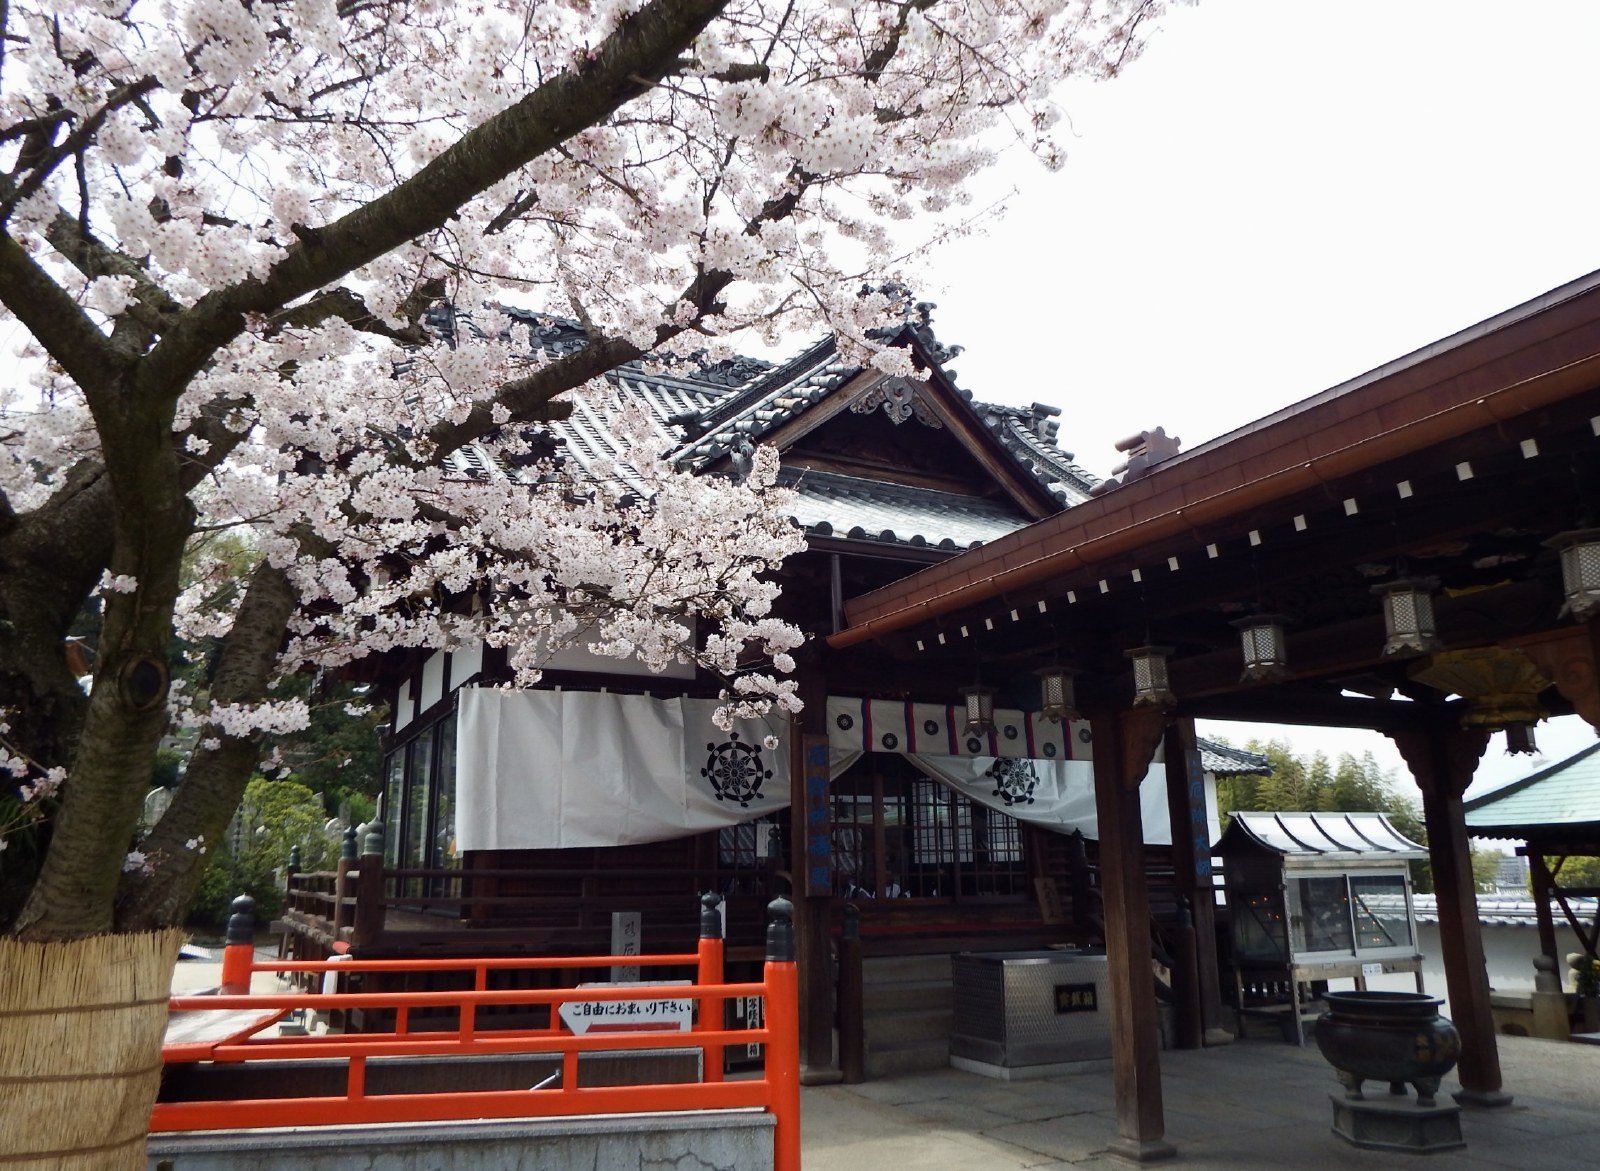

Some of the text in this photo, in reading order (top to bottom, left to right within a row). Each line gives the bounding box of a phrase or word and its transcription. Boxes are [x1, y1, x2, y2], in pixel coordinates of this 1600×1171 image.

[573, 1001, 691, 1016] ご自由におまいり下さい
